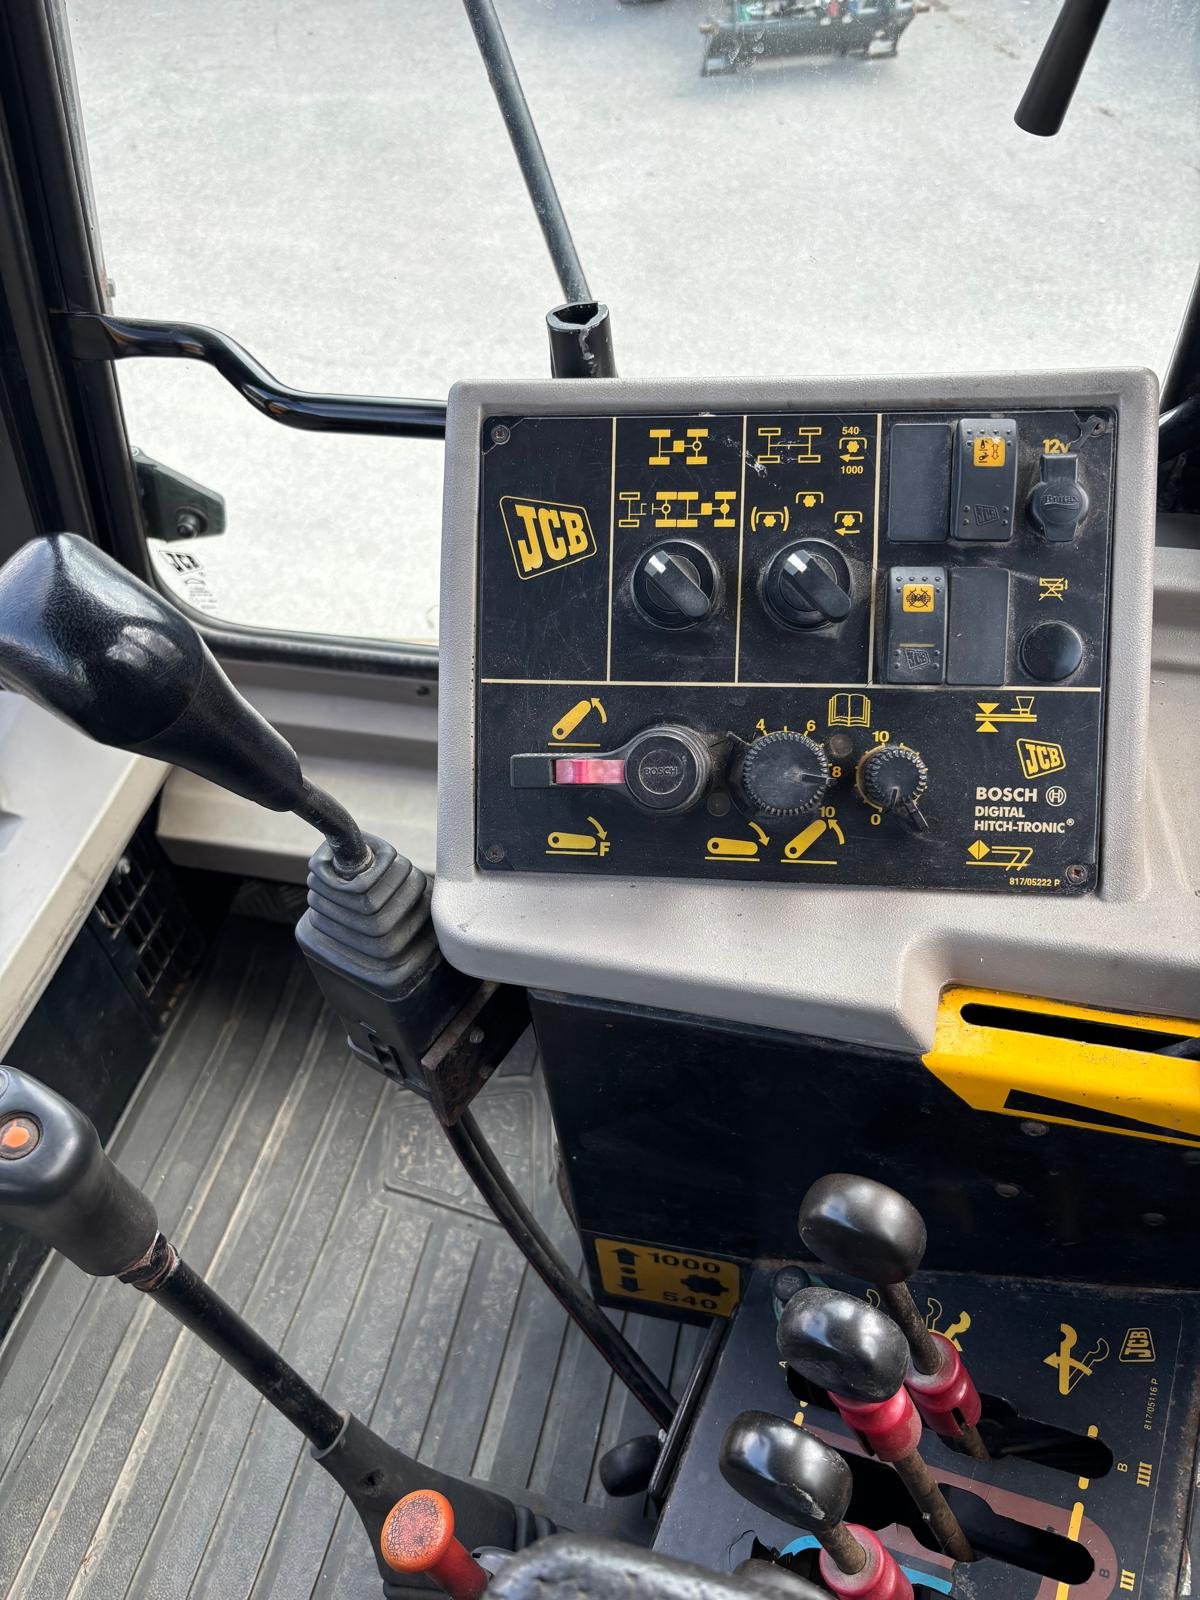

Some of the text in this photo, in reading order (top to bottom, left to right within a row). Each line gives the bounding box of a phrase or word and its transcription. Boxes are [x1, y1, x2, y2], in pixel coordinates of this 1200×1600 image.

[842, 426, 860, 435] 540
[841, 465, 864, 474] 1000
[515, 504, 588, 572] JCB
[756, 718, 765, 731] 4
[806, 719, 816, 732] 6
[872, 730, 890, 743] 10
[1025, 743, 1061, 775] JCB
[643, 766, 678, 776] BOSCH
[831, 765, 842, 778] 8
[976, 786, 1038, 803] BOSCH
[819, 806, 836, 818] 10
[974, 805, 1026, 818] DIGITAL
[870, 813, 881, 826] 0
[600, 841, 610, 857] F
[1009, 877, 1061, 887] 817/05222 P
[649, 1252, 721, 1274] 1000
[663, 1291, 718, 1310] 540
[1124, 1330, 1152, 1358] JCB
